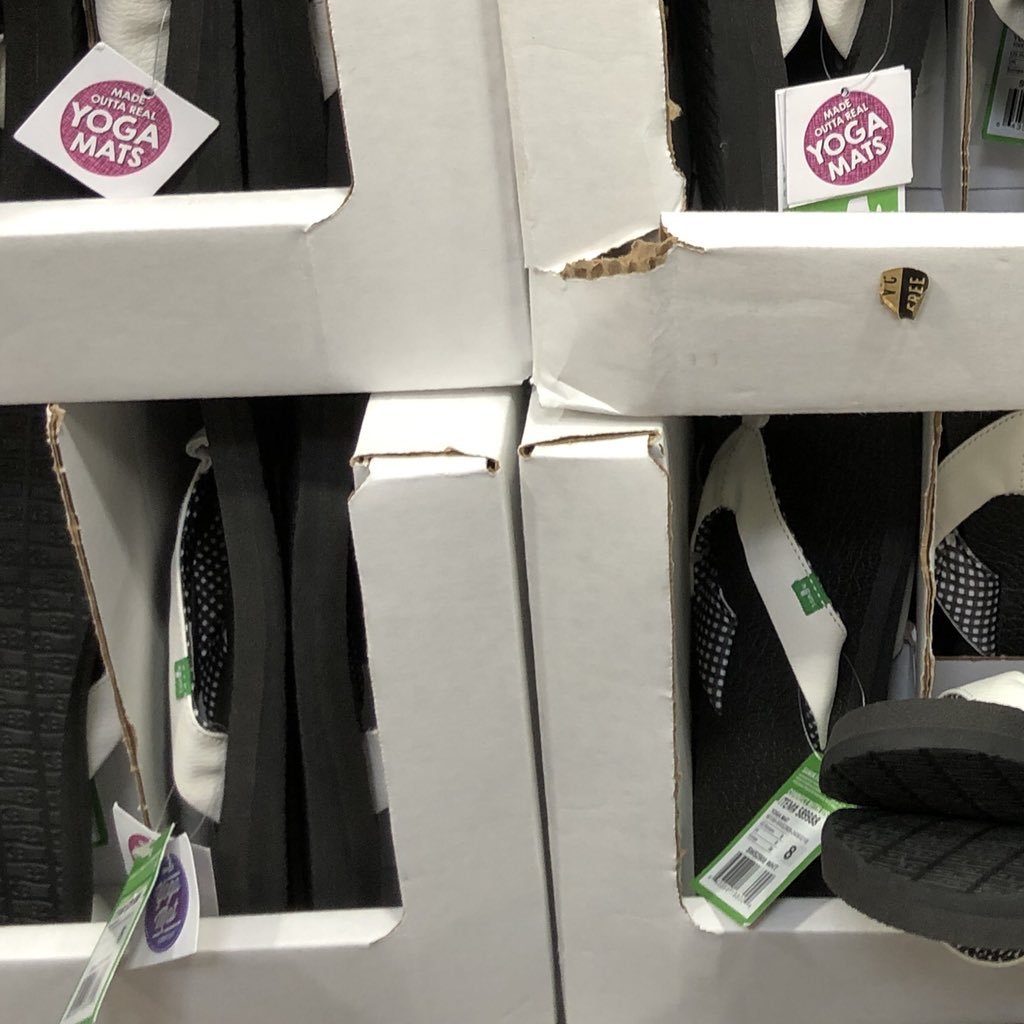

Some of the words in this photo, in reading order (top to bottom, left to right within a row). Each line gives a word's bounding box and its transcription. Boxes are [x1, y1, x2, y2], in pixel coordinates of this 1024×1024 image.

[91, 94, 126, 112] OUTTA
[129, 104, 157, 121] REAL
[111, 87, 147, 105] MADE
[823, 98, 852, 120] MADE
[71, 101, 159, 150] YOGA
[814, 117, 845, 137] OUTTA
[845, 103, 869, 121] REAL
[69, 132, 145, 168] MATS
[806, 111, 888, 165] YOGA
[827, 136, 887, 181] MATS
[784, 845, 797, 860] 8
